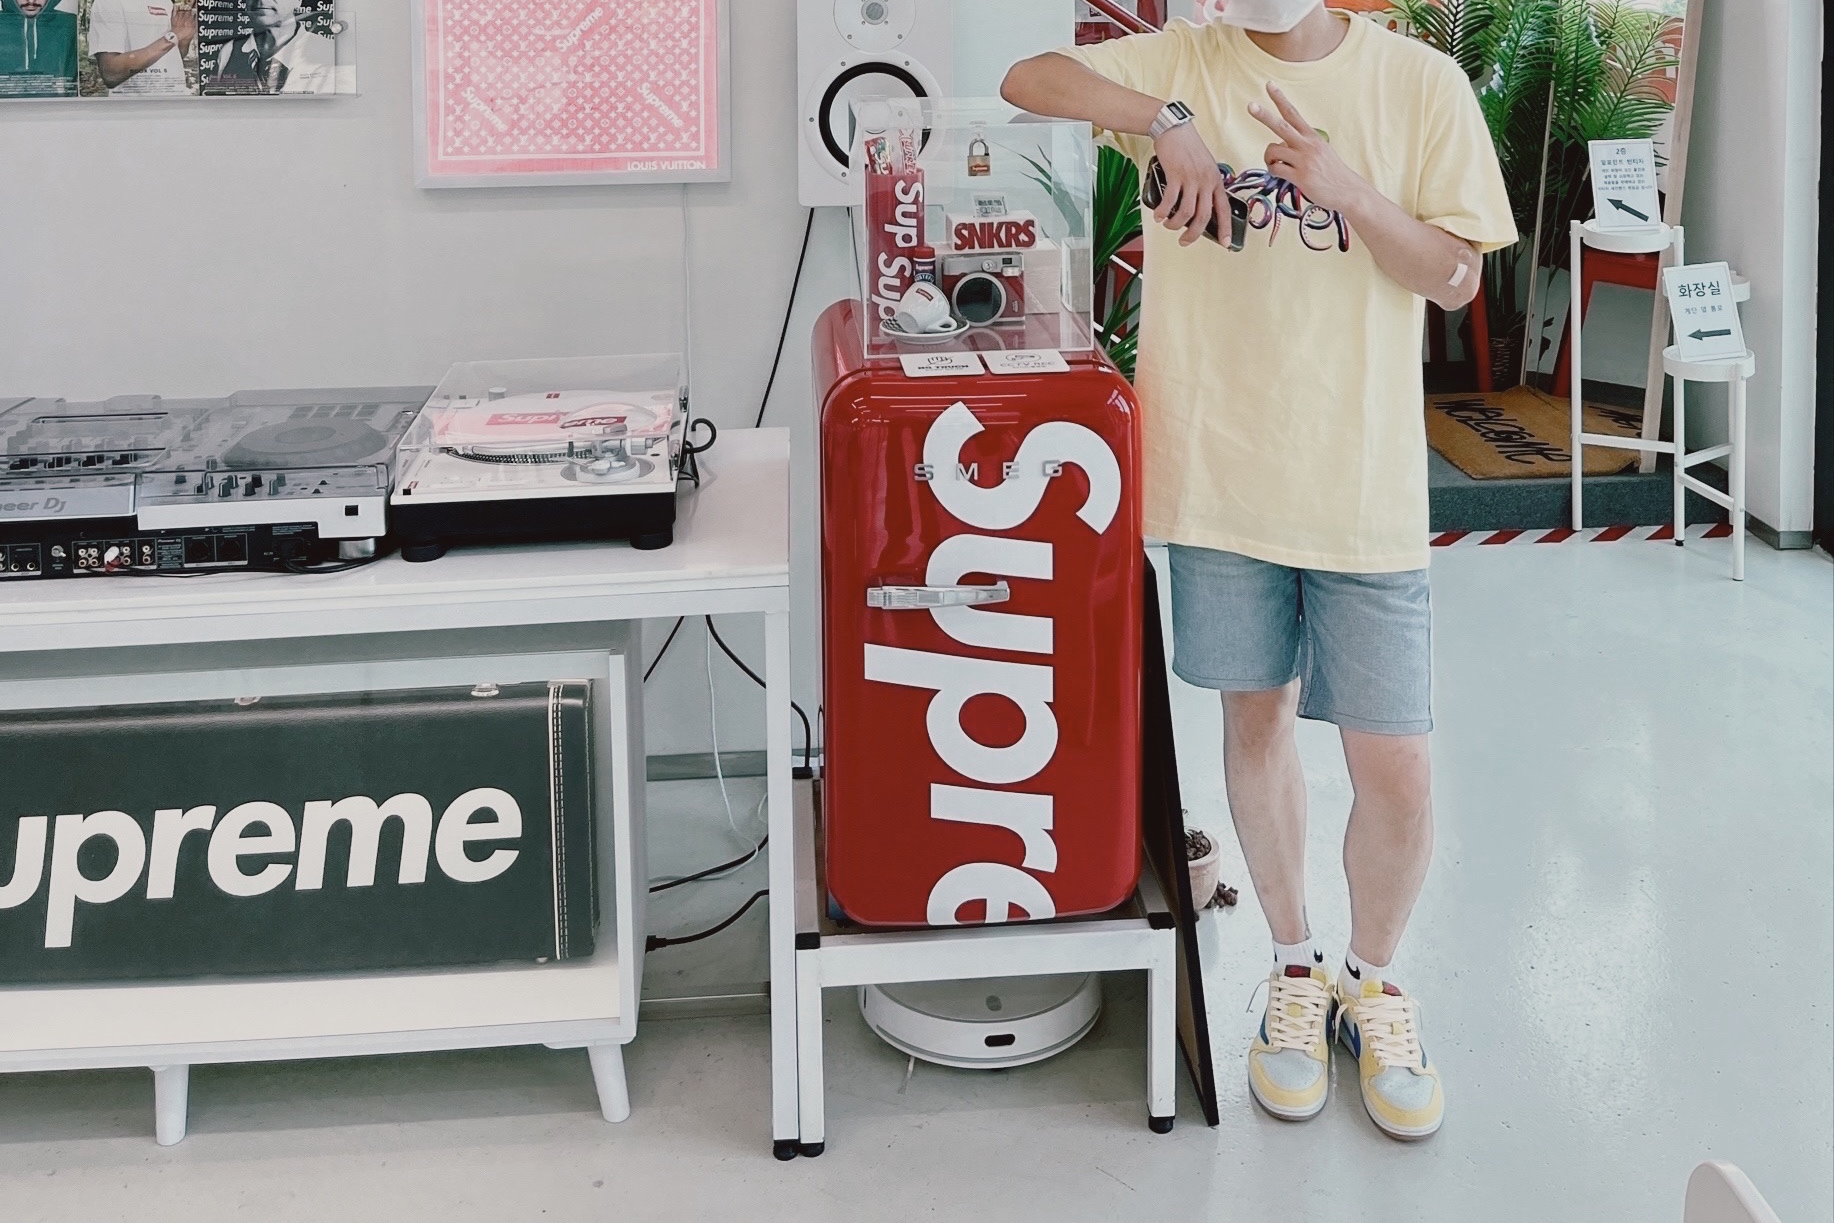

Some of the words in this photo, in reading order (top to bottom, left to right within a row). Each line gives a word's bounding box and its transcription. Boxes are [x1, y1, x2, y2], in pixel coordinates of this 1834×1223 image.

[555, 6, 604, 53] Supreme
[460, 86, 508, 132] Supreme
[637, 82, 685, 128] Supreme
[627, 160, 658, 171] LOUIS
[660, 159, 706, 170] VUITTON
[954, 219, 1036, 251] SNKRS
[1678, 280, 1721, 298] 화장실
[914, 459, 1063, 482] SMEG
